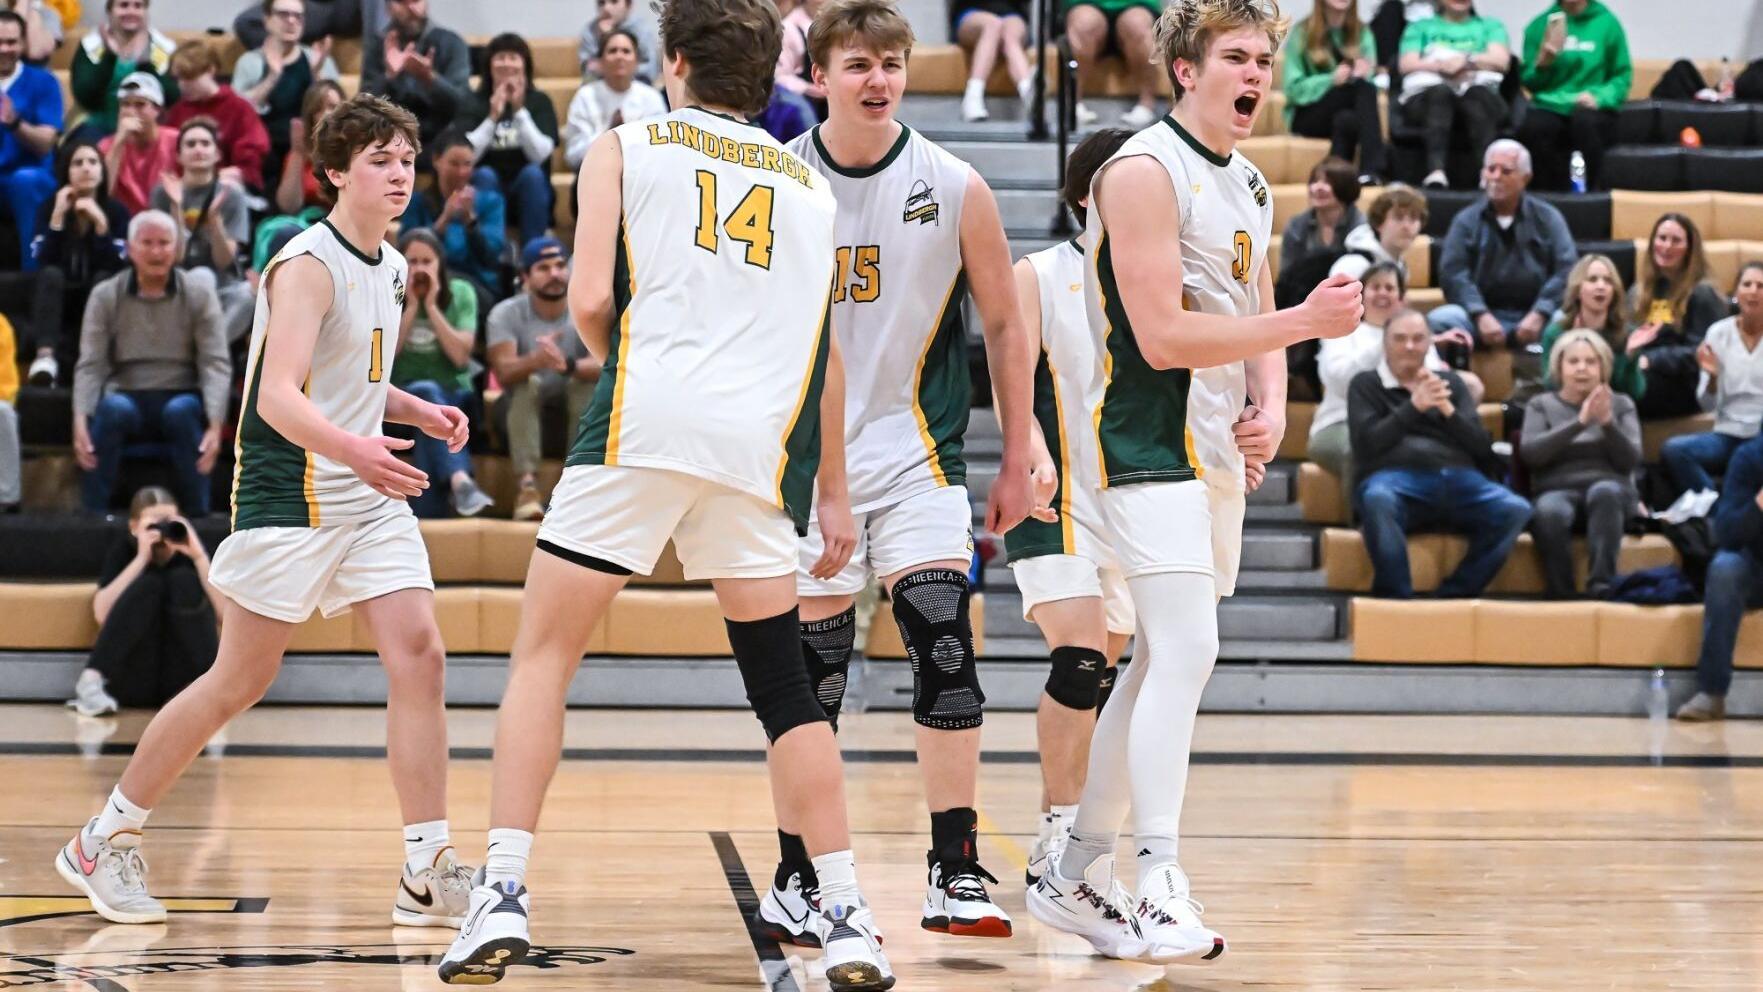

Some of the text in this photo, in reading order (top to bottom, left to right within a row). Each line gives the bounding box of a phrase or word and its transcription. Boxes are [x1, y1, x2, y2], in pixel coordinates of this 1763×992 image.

[647, 121, 813, 190] LINDBERGH
[695, 169, 774, 271] 14
[833, 245, 880, 303] 15
[368, 328, 383, 383] 1
